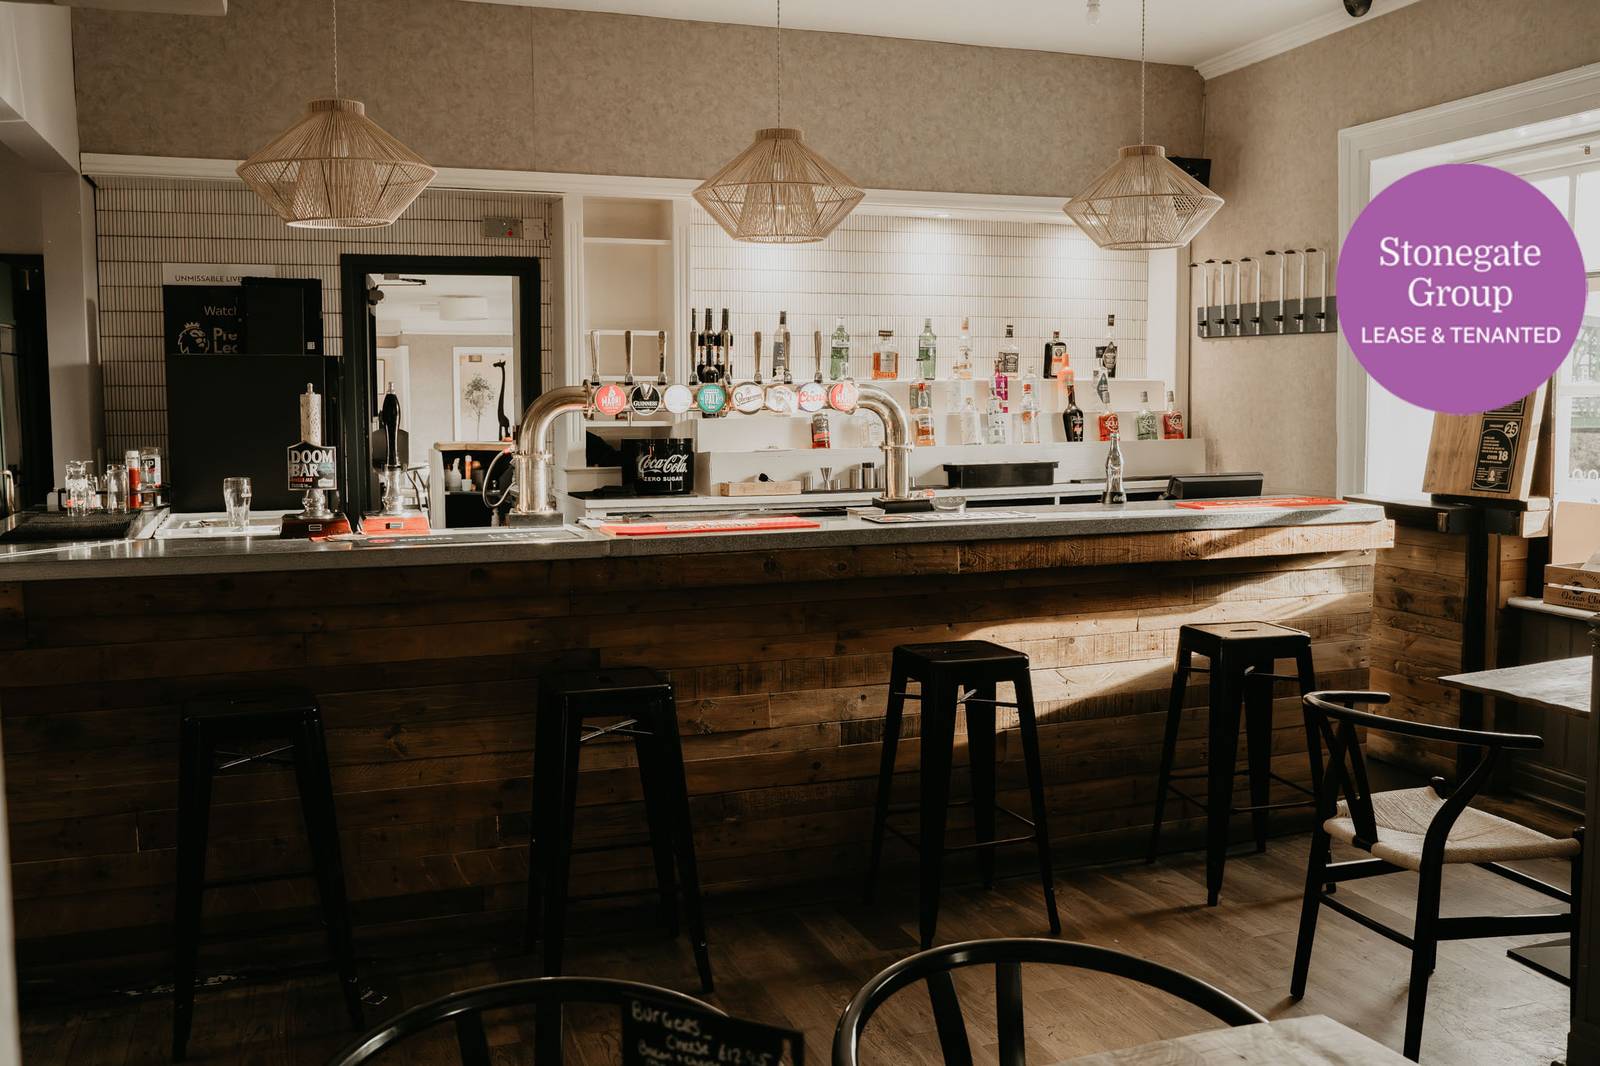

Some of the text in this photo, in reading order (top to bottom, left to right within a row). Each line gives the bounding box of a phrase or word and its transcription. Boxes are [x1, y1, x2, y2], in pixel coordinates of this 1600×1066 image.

[175, 274, 224, 283] UNMISSABLE
[1505, 424, 1517, 434] 25
[290, 449, 334, 464] DOOM
[1498, 450, 1509, 461] 18
[290, 464, 320, 477] BAR
